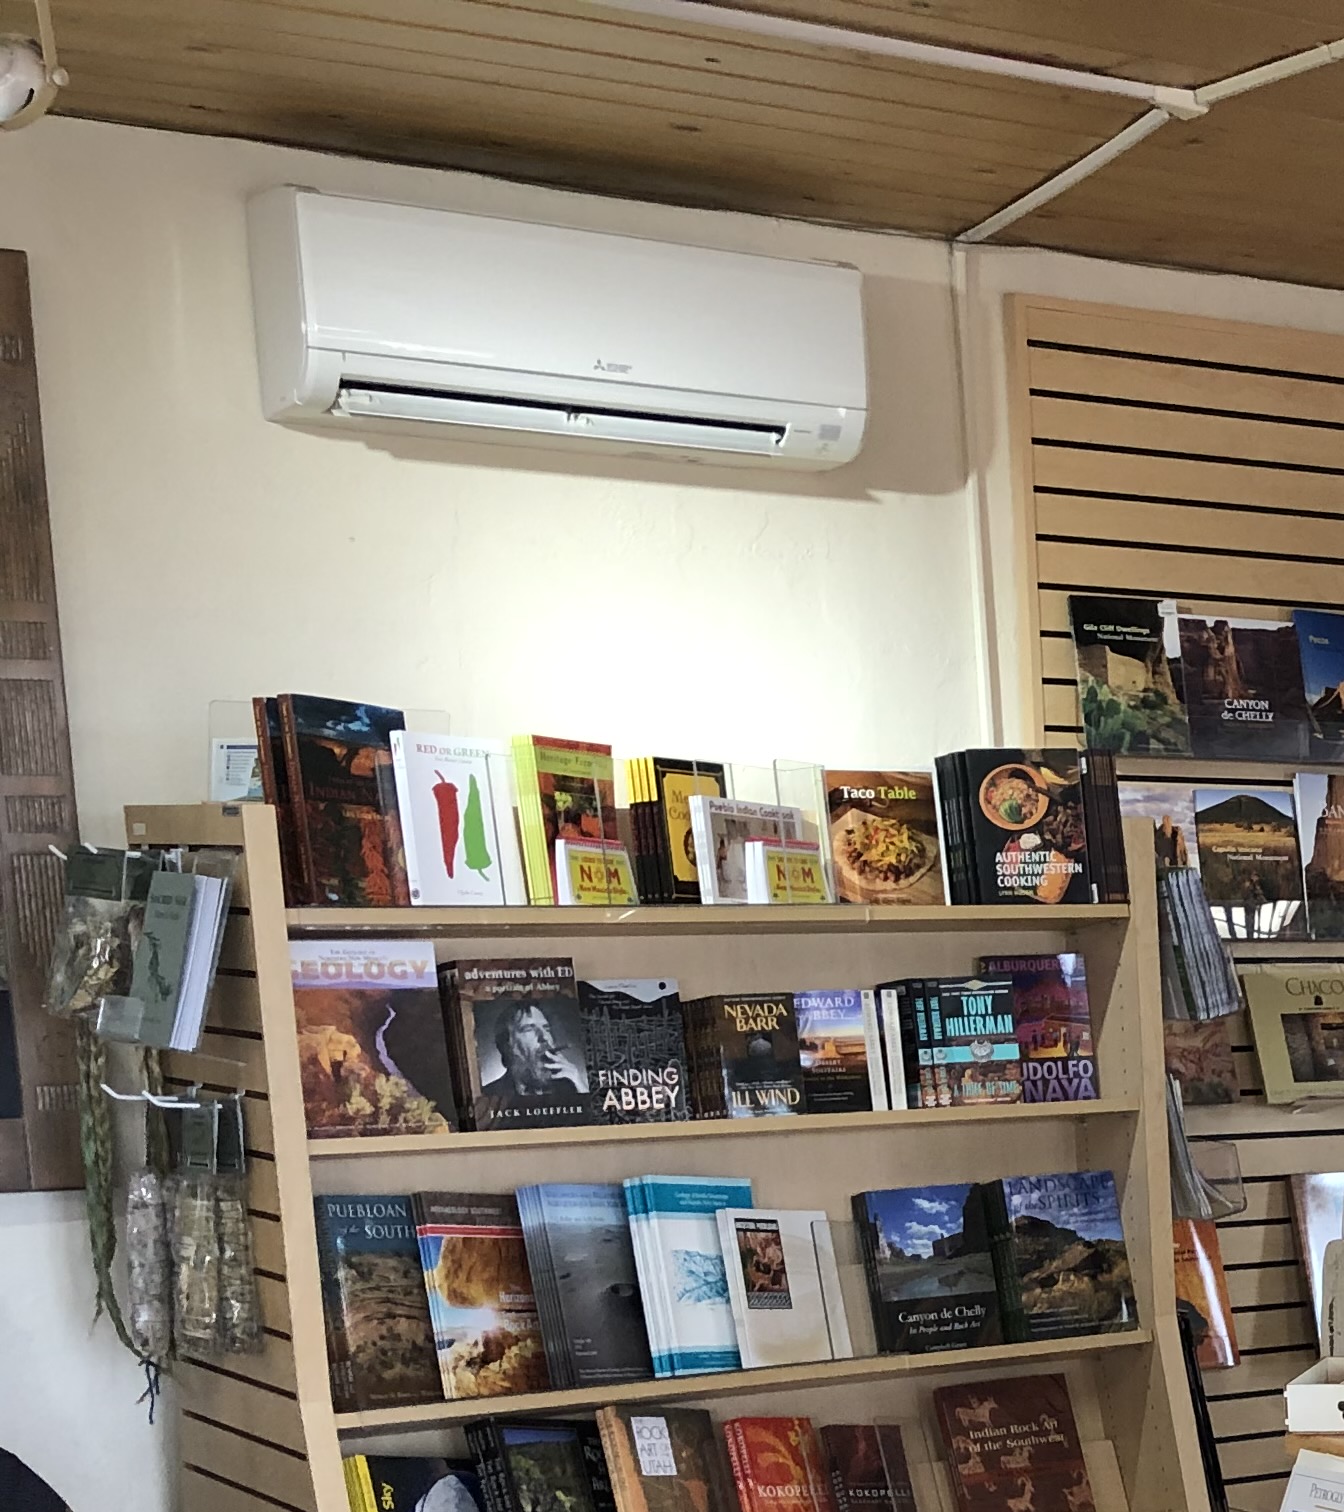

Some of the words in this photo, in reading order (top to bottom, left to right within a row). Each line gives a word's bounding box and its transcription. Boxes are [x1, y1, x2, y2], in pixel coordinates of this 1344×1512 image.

[1224, 698, 1269, 711] CANYON
[1221, 711, 1234, 720] de
[1235, 710, 1274, 722] CHELLY
[416, 743, 437, 755] RED
[453, 747, 490, 759] GREEN
[839, 785, 876, 800] Taco
[877, 784, 917, 801] Table
[994, 851, 1057, 864] AUTHENTIC
[995, 862, 1083, 876] SOUTHWESTERN
[996, 874, 1049, 887] COOKING
[464, 966, 527, 982] adventures
[529, 966, 555, 980] with
[555, 966, 573, 979] ED
[1286, 976, 1344, 997] CHACO
[724, 1003, 788, 1019] NEVADA
[960, 995, 993, 1016] TONY
[736, 1016, 780, 1032] BARR
[945, 1013, 1014, 1037] HILLERMAN
[599, 1067, 679, 1088] FINDING
[603, 1085, 681, 1112] ABBEY
[733, 1089, 757, 1109] ILL
[757, 1087, 801, 1107] WIND
[490, 1107, 522, 1119] JACK
[526, 1105, 583, 1118] LOEFFLER
[1038, 1191, 1101, 1210] SPIRITS
[327, 1202, 408, 1219] PUEBLOAN
[898, 1308, 939, 1327] Canyon
[940, 1308, 954, 1321] de
[955, 1304, 987, 1322] Chelly
[635, 1423, 667, 1441] ROCK
[969, 1425, 1008, 1441] Indian
[1009, 1423, 1040, 1437] Rock
[1041, 1420, 1059, 1434] Art
[640, 1442, 657, 1455] ART
[967, 1440, 981, 1452] of
[982, 1437, 1004, 1451] the
[1005, 1432, 1065, 1449] Southwest
[643, 1458, 674, 1474] UTAH
[379, 1482, 399, 1511] Sky
